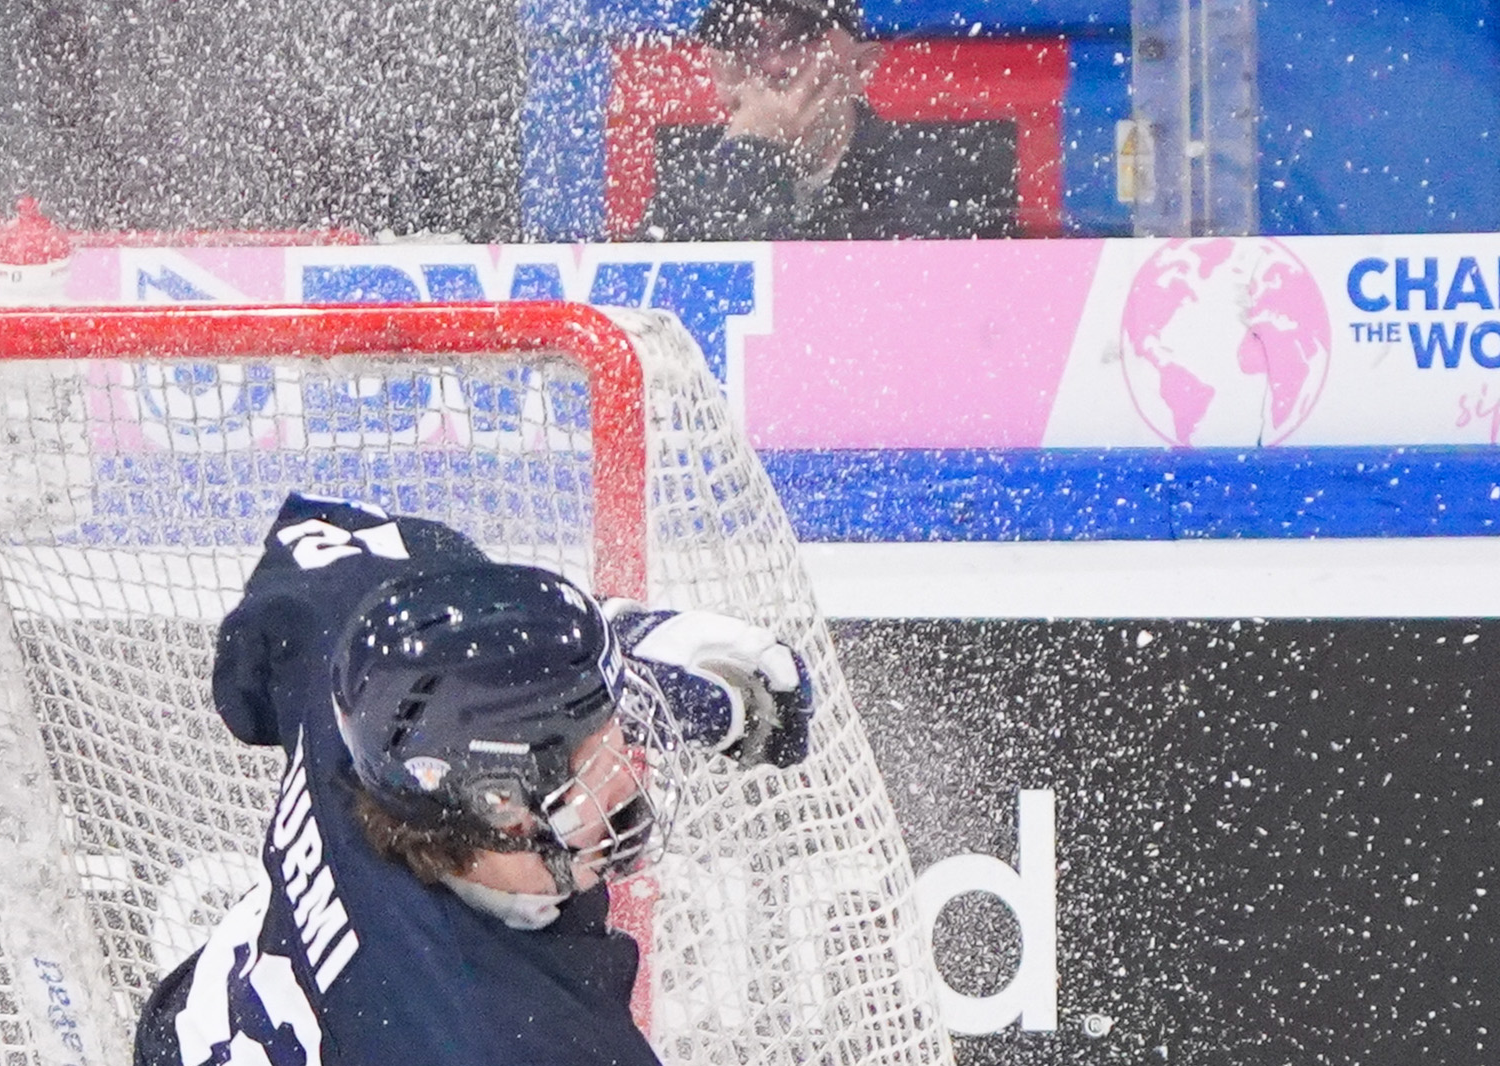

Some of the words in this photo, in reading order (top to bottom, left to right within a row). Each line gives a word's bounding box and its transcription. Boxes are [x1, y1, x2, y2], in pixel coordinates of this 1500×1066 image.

[1347, 257, 1500, 312] CHA
[301, 262, 755, 433] BWT
[1350, 323, 1401, 342] THE
